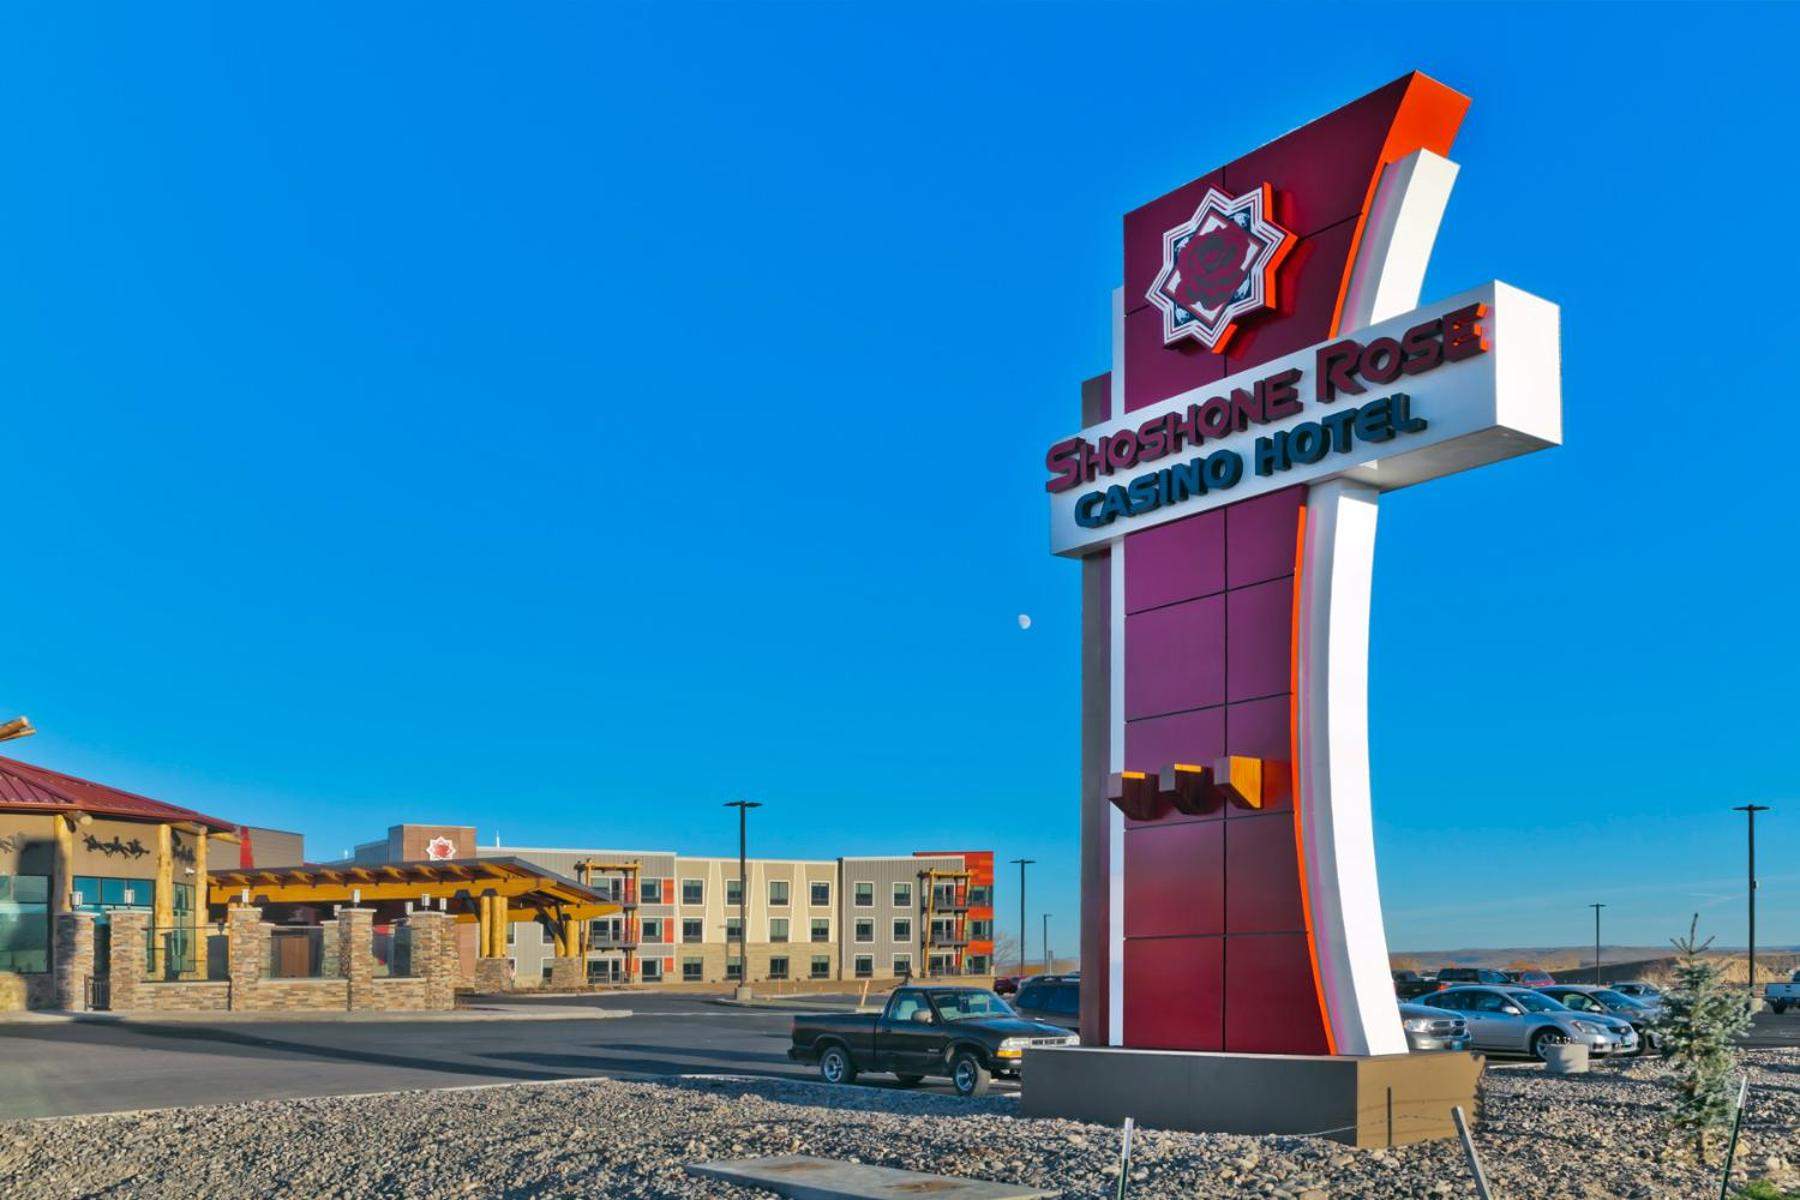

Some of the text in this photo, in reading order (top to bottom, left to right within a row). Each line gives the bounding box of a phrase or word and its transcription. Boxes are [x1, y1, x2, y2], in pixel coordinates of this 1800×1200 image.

[1046, 302, 1488, 493] SHOSHONE ROSE
[1074, 392, 1428, 529] CASINO HOTEL
